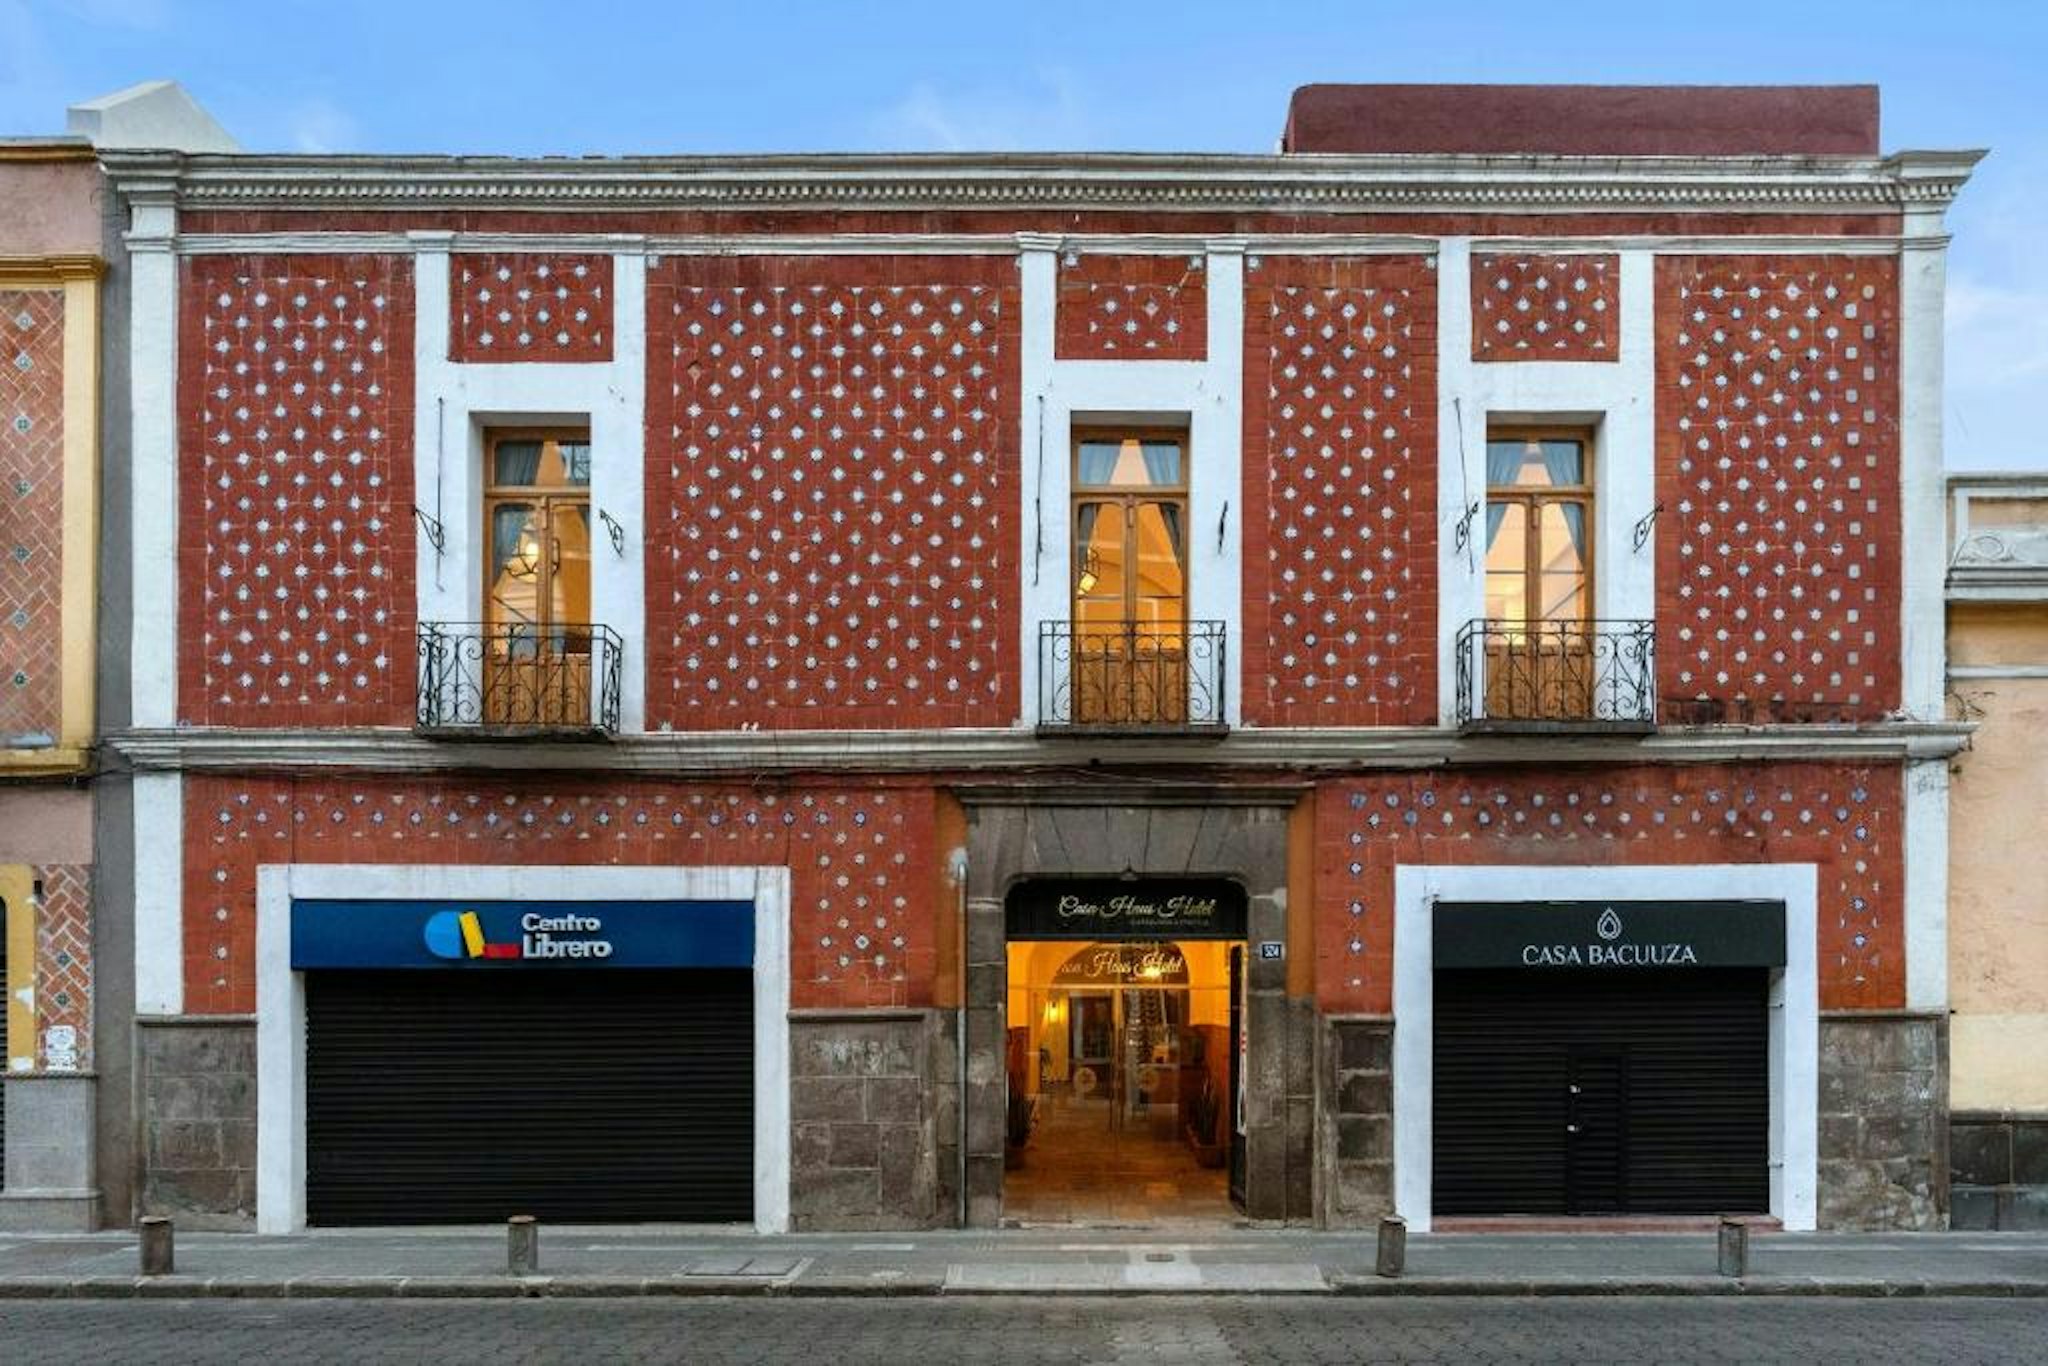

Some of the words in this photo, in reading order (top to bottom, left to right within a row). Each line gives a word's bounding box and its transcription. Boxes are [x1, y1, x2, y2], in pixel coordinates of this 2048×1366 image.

[521, 912, 601, 932] Centro
[522, 932, 613, 958] Librero
[1522, 944, 1582, 966] CASA
[1588, 944, 1698, 966] BACUUZA
